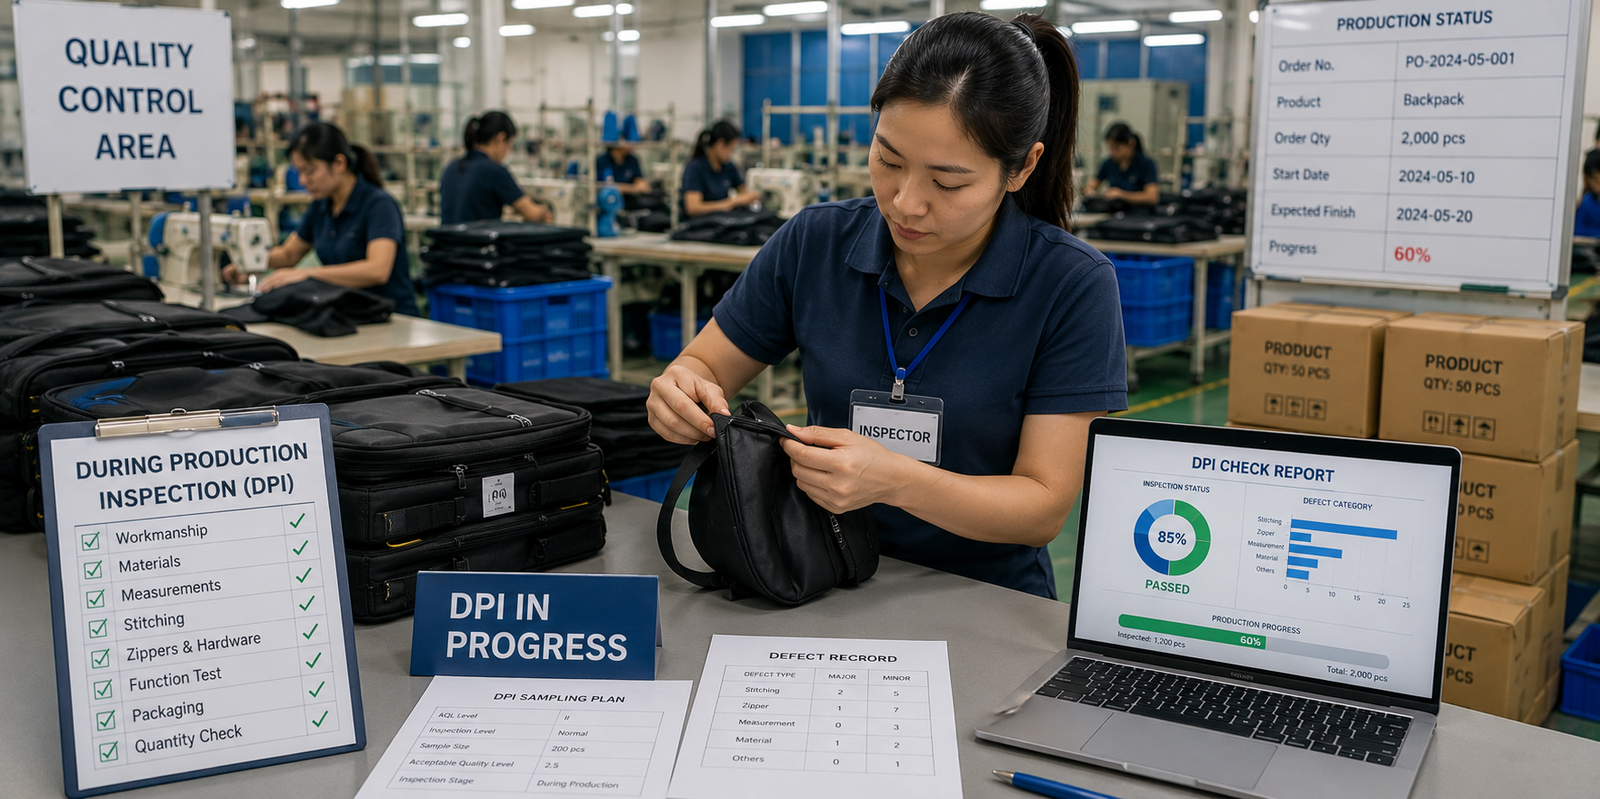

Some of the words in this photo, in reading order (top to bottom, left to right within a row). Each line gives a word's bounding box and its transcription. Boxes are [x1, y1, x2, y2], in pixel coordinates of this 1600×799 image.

[1337, 14, 1431, 30] PRODUCTION
[1436, 10, 1492, 26] STATUS
[66, 38, 192, 68] QUALITY
[1406, 52, 1514, 68] PO-2024-05-001
[1279, 60, 1311, 72] Order
[1315, 60, 1334, 70] No.
[59, 86, 202, 113] CONTROL
[1277, 96, 1321, 108] Product
[1404, 93, 1464, 108] Backpack
[96, 134, 175, 159] AREA
[1275, 132, 1306, 144] Order
[1310, 132, 1330, 147] Qty
[1402, 132, 1439, 145] 2,000
[1443, 135, 1465, 147] pcs
[1273, 168, 1299, 180] Start
[1303, 169, 1329, 180] Date
[1399, 170, 1474, 183] 2024-05-10
[1271, 204, 1320, 217] Expected
[1324, 206, 1355, 218] Finish
[1397, 208, 1472, 223] 2024-05-20
[1269, 240, 1317, 256] Progress
[1395, 247, 1430, 262] 60%
[1265, 341, 1332, 359] PRODUCT
[1264, 362, 1288, 374] QTY:
[1292, 364, 1305, 377] 50
[1308, 367, 1330, 380] PCS
[1425, 354, 1503, 374] PRODUCT
[1424, 377, 1452, 391] QTY:
[1456, 380, 1472, 393] 50
[1475, 382, 1500, 396] PCS
[860, 425, 930, 443] INSPECTOR
[77, 456, 162, 479] DURING
[170, 443, 307, 472] PRODUCTION
[1192, 457, 1215, 470] DPI
[1220, 460, 1269, 476] CHECK
[1275, 465, 1334, 482] REPORT
[100, 480, 236, 509] INSPECTION
[244, 473, 293, 498] (DPI)
[1143, 481, 1183, 490] INSPECTION
[1185, 485, 1209, 493] STATUS
[1303, 497, 1331, 506] DEFECT
[1333, 501, 1372, 510] CATEGORY
[1468, 505, 1494, 520] PCS
[116, 525, 207, 544] Workmanship
[1158, 531, 1186, 545] 85%
[119, 556, 180, 572] Materials
[1256, 566, 1274, 574] Others
[122, 580, 221, 601] Measurements
[1146, 580, 1189, 594] PASSED
[450, 593, 504, 619] DPI
[517, 594, 549, 620] IN
[124, 614, 184, 631] Stitching
[1212, 615, 1260, 629] PRODUCTION
[1262, 623, 1300, 634] PROGRESS
[127, 641, 178, 662] Zippers
[183, 641, 193, 653] &
[197, 632, 260, 651] Hardware
[447, 631, 627, 661] PROGRESS
[1118, 631, 1152, 643] Inspected:
[1155, 636, 1173, 647] 1,200
[1241, 635, 1261, 647] 60%
[830, 654, 897, 662] RECRORD
[130, 673, 189, 691] Function
[193, 668, 221, 681] Test
[1327, 666, 1347, 675] Total:
[1350, 670, 1372, 679] 2,000
[1446, 667, 1473, 684] PCS
[520, 694, 586, 702] SAMPLING
[133, 702, 203, 722] Packaging
[135, 733, 195, 753] Quantity
[200, 725, 242, 742] Check
[399, 776, 446, 784] Inspection
[449, 777, 474, 785] Stage
[537, 780, 567, 788] During
